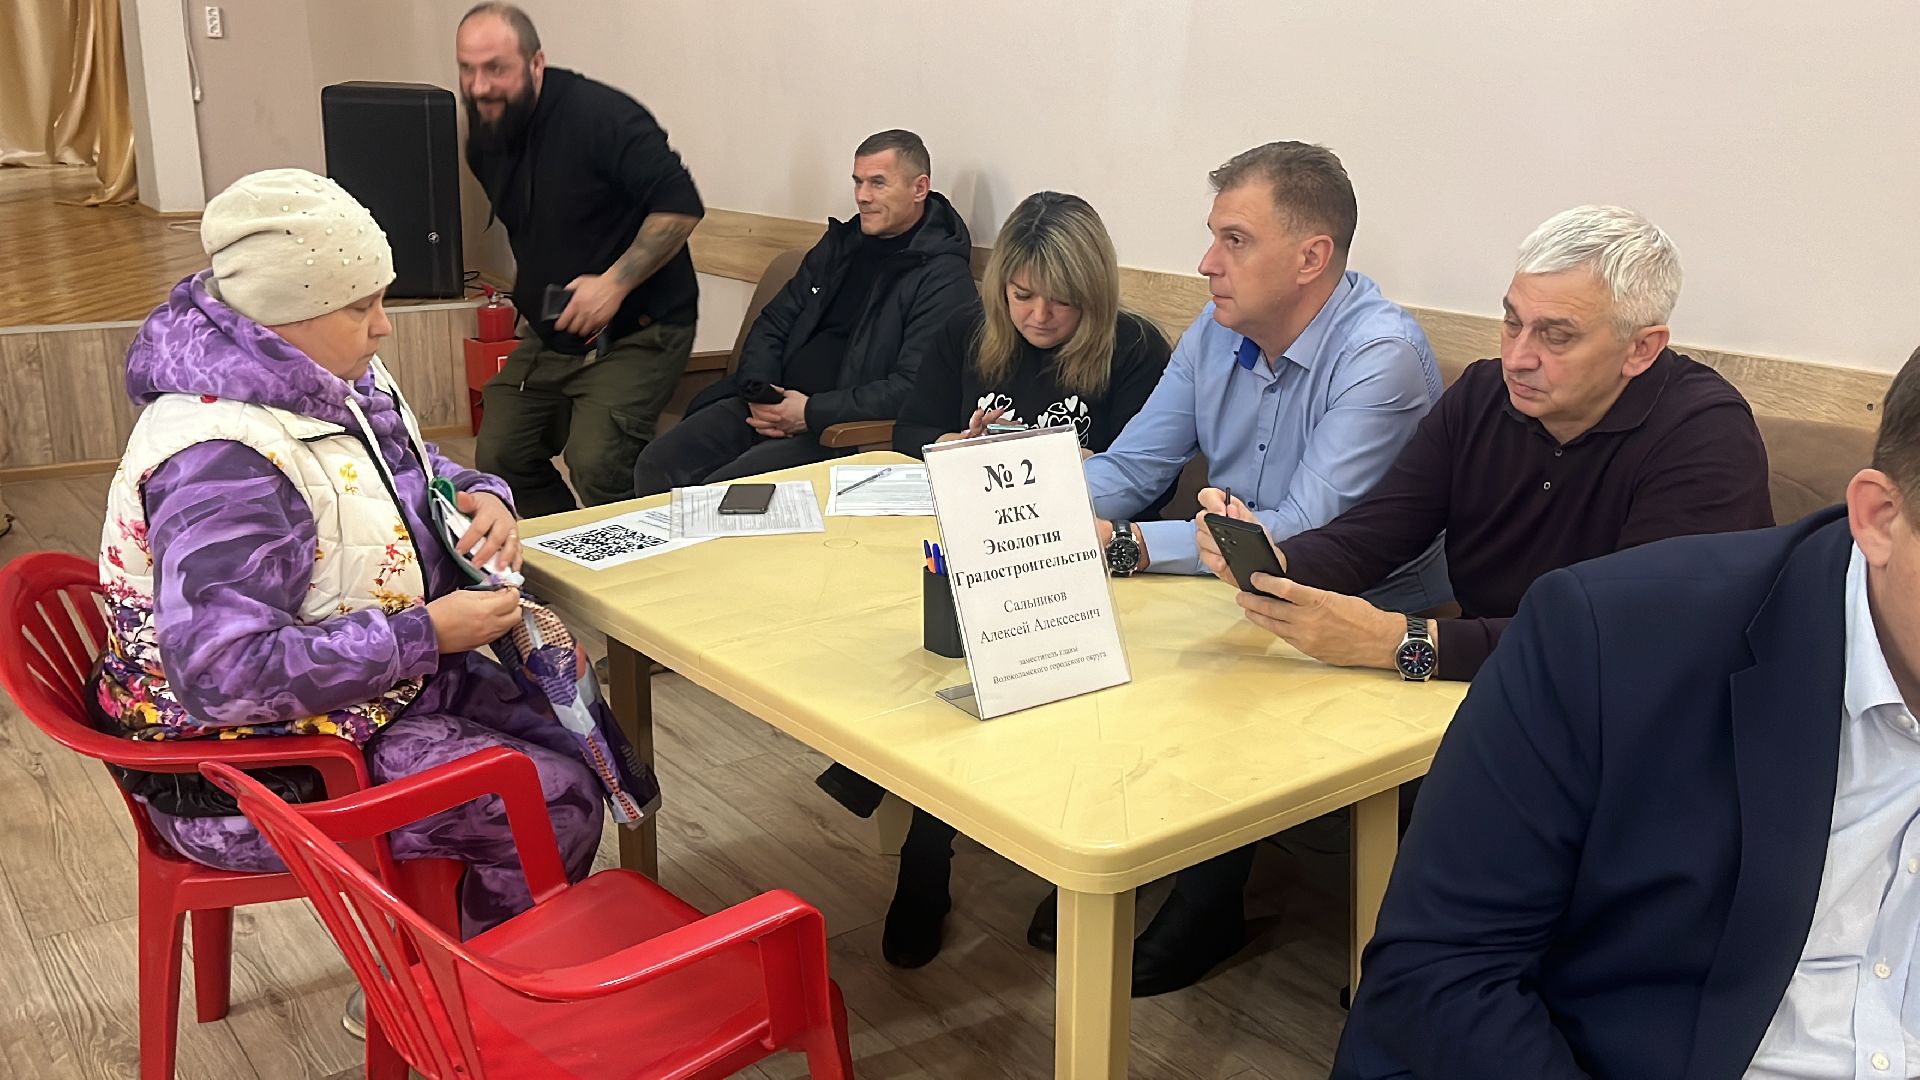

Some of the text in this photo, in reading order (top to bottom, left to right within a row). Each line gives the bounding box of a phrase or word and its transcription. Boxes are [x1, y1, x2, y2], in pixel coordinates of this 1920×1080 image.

[984, 458, 1036, 492] № 2
[994, 503, 1040, 526] ЖКХ
[983, 530, 1062, 556] Экология
[954, 548, 1098, 588] Градостроительство
[1003, 590, 1067, 613] Сальников
[980, 608, 1101, 644] Алексей Алексеевич
